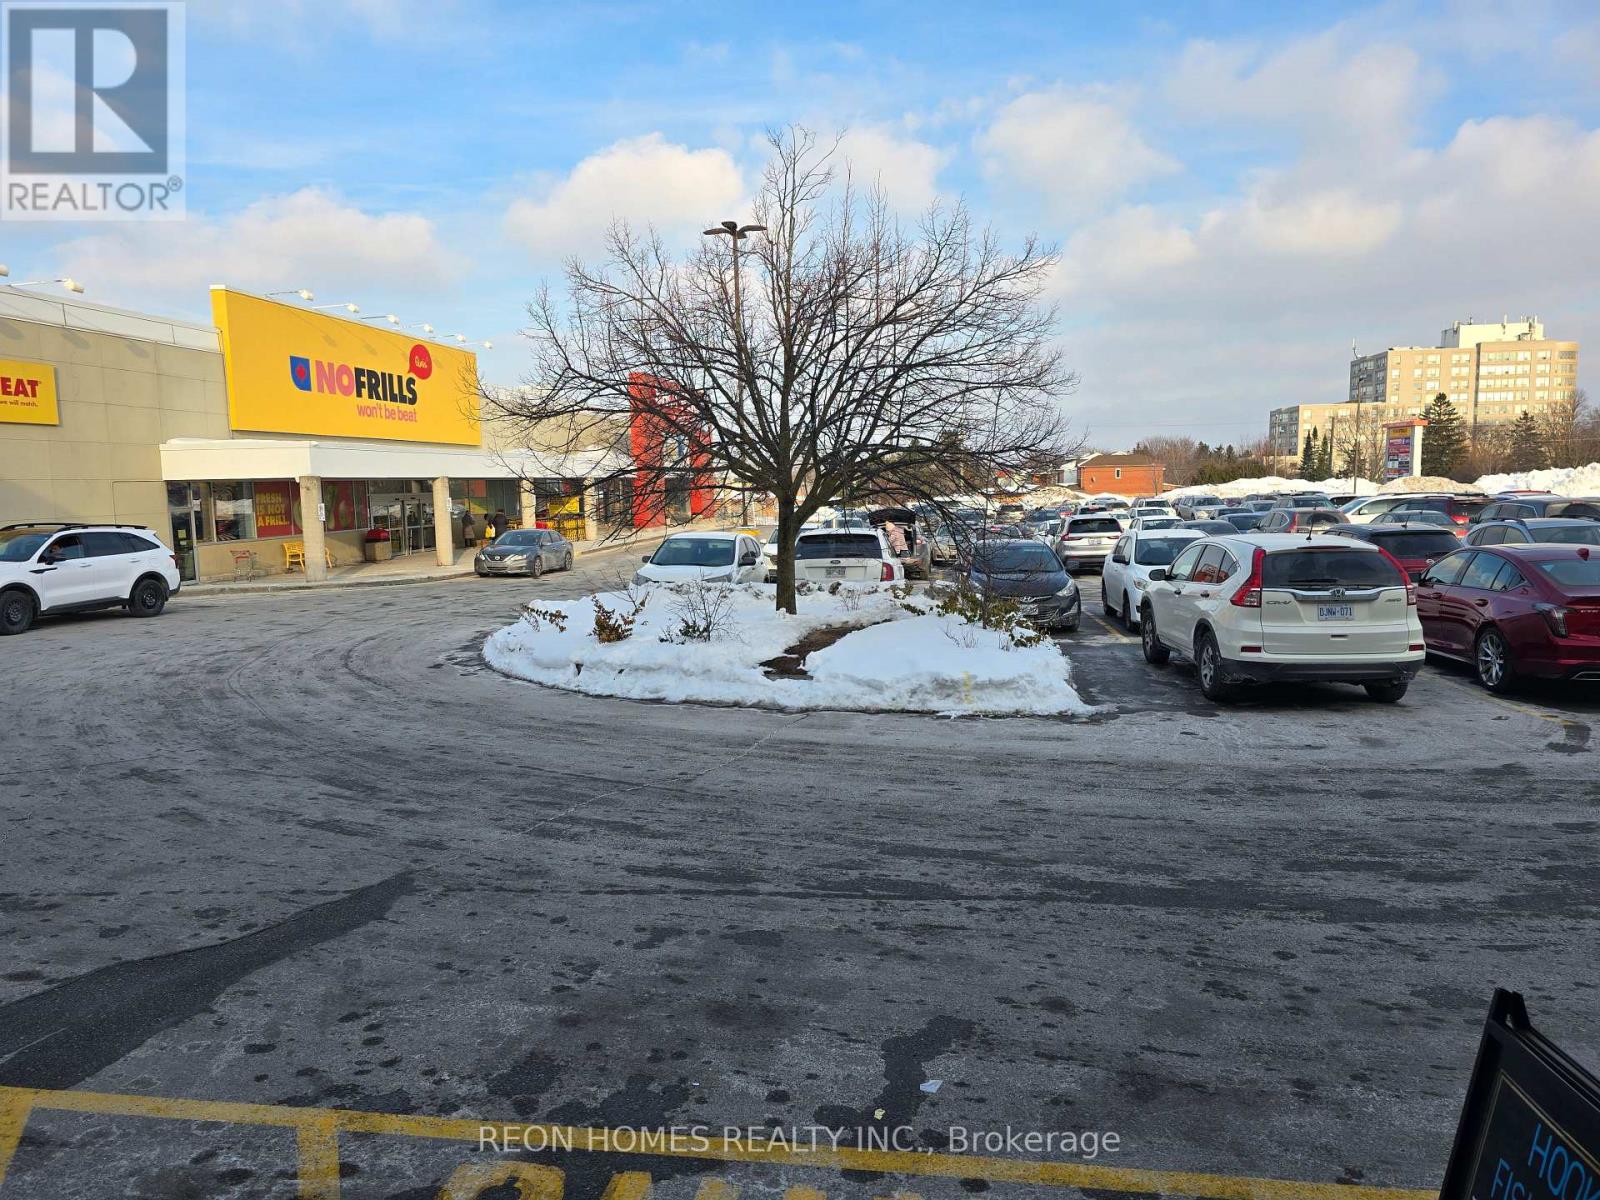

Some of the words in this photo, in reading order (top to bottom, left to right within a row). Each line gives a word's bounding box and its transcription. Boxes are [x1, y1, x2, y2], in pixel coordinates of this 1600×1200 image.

[356, 402, 383, 418] won't
[384, 403, 396, 420] be
[397, 405, 418, 423] beat
[256, 504, 266, 515] IS
[267, 503, 285, 515] NOT
[257, 515, 265, 528] A
